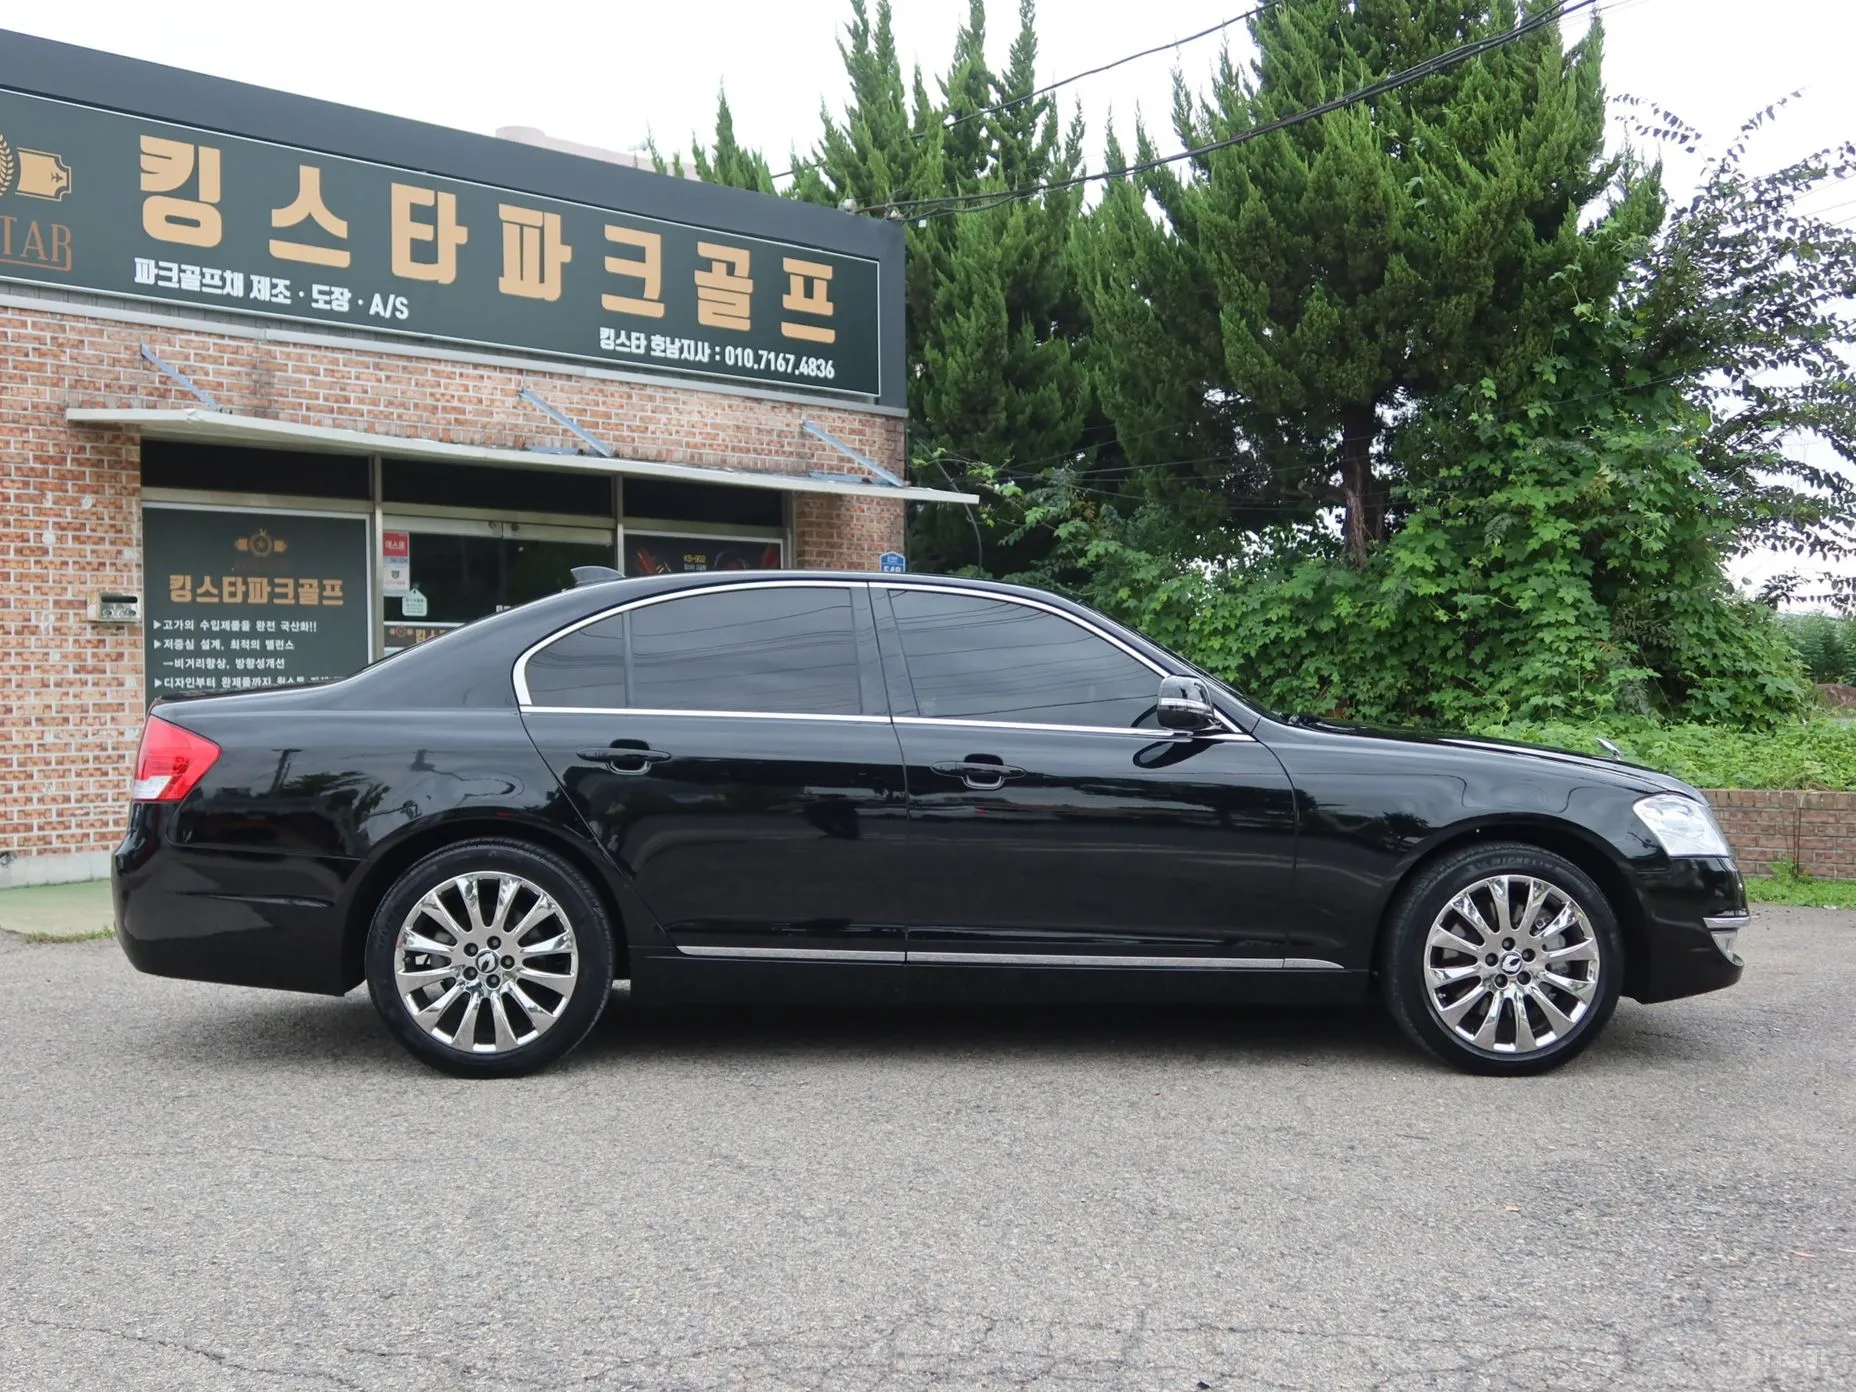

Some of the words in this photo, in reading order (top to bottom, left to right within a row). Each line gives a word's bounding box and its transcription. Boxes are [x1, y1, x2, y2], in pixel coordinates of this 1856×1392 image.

[140, 134, 836, 343] 킹스타파크골프
[134, 257, 244, 298] 파크골프채
[249, 274, 292, 305] 제조
[311, 283, 352, 312] 도장
[369, 293, 410, 320] A/S
[599, 327, 648, 355] 킹스타
[650, 334, 711, 363] 호남지사
[724, 345, 835, 379] 010.7167.4836
[169, 574, 344, 606] 킹스타파크골프
[163, 619, 195, 632] 고가의
[199, 619, 251, 632] 수입제품을
[255, 620, 276, 632] 완전
[163, 638, 195, 651] 저중심
[235, 657, 286, 670] 방향성개선
[164, 676, 216, 689] 디자인부터
